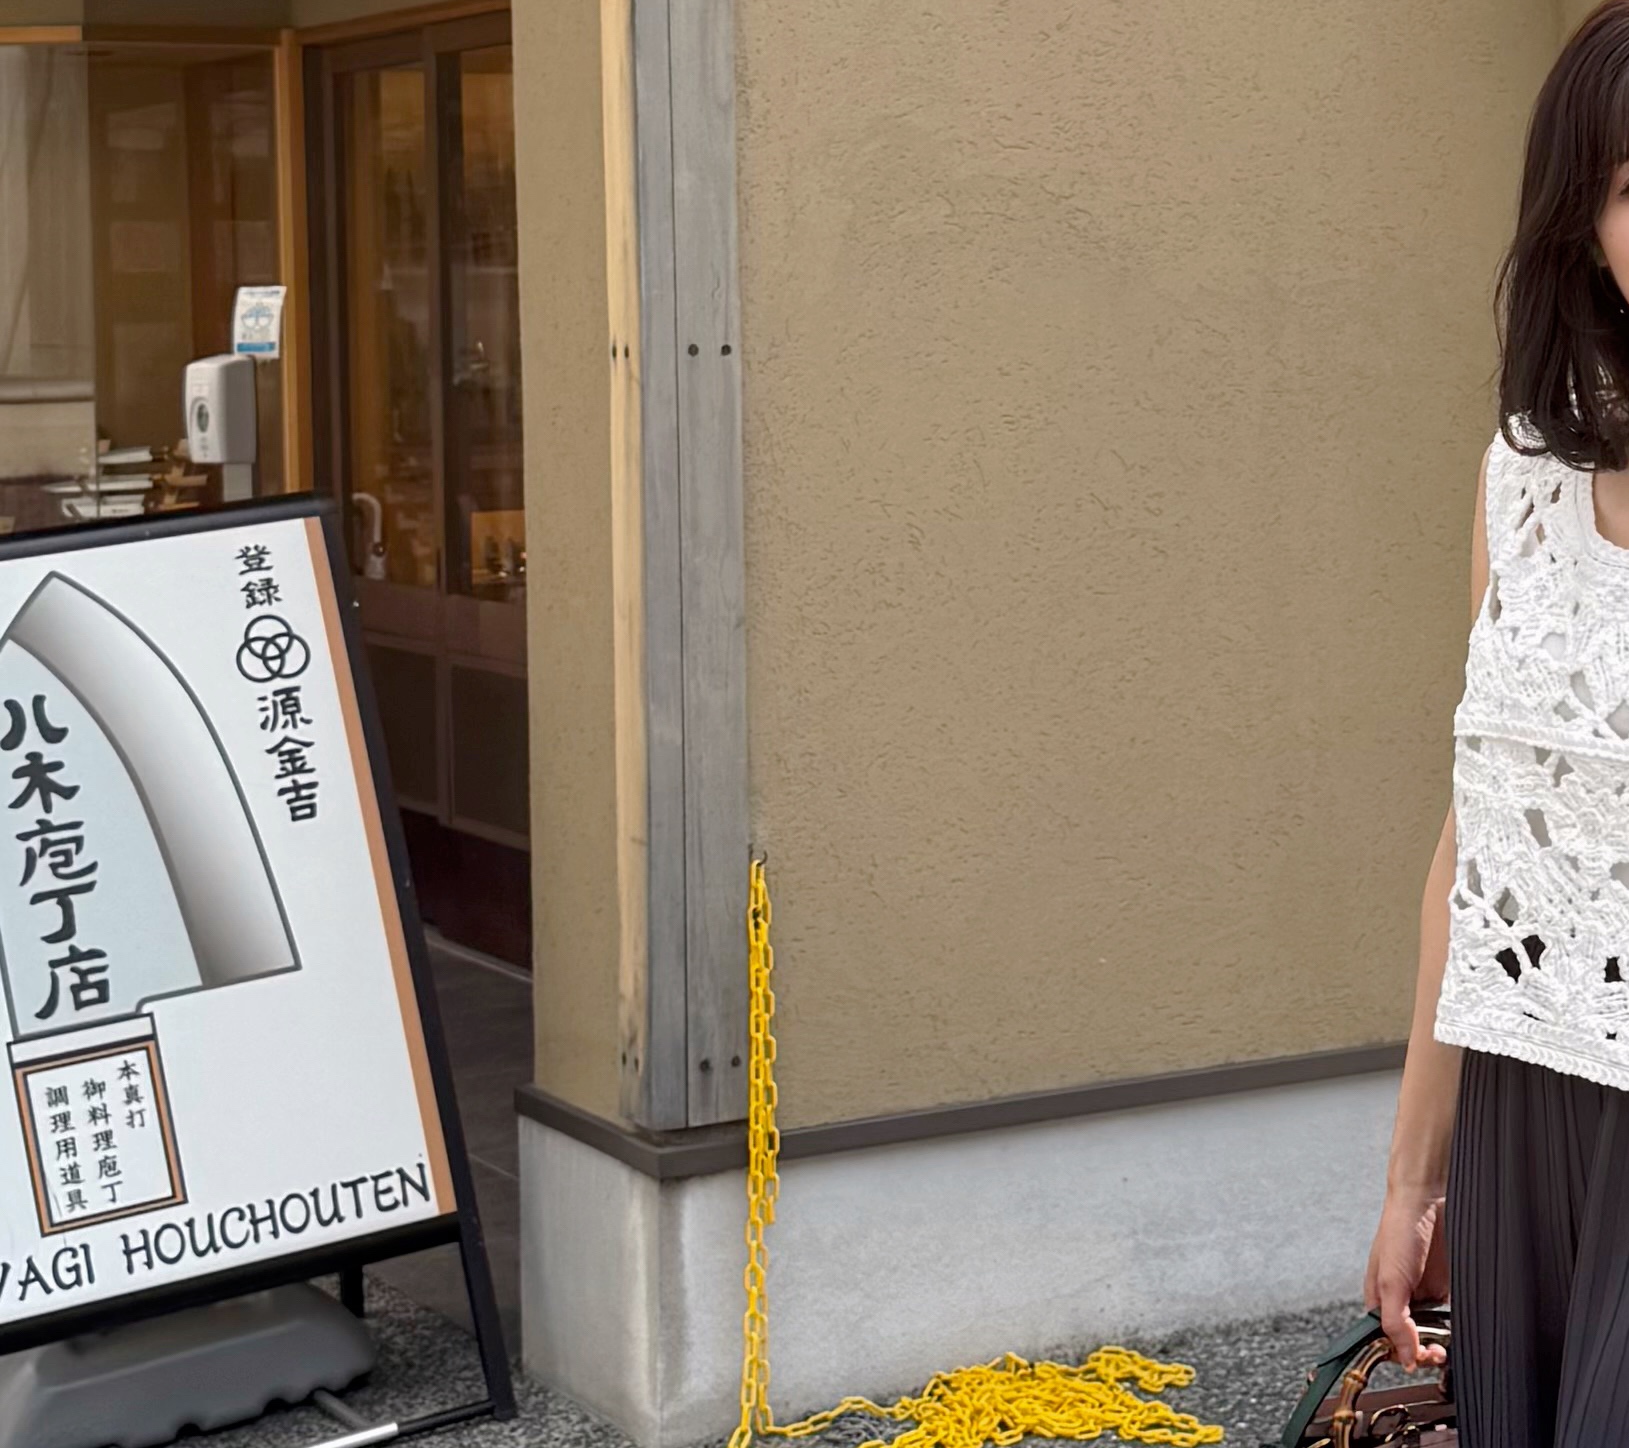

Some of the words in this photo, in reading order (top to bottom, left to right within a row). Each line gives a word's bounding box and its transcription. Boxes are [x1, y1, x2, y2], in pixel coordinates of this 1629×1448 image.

[235, 544, 283, 609] 登録
[257, 685, 319, 822] 源金吉
[0, 694, 110, 1020] 八木庖丁店
[45, 1085, 88, 1213] 調理用道具
[82, 1078, 123, 1203] 御料理庖丁
[121, 1162, 431, 1274] HOUCHOUTEN
